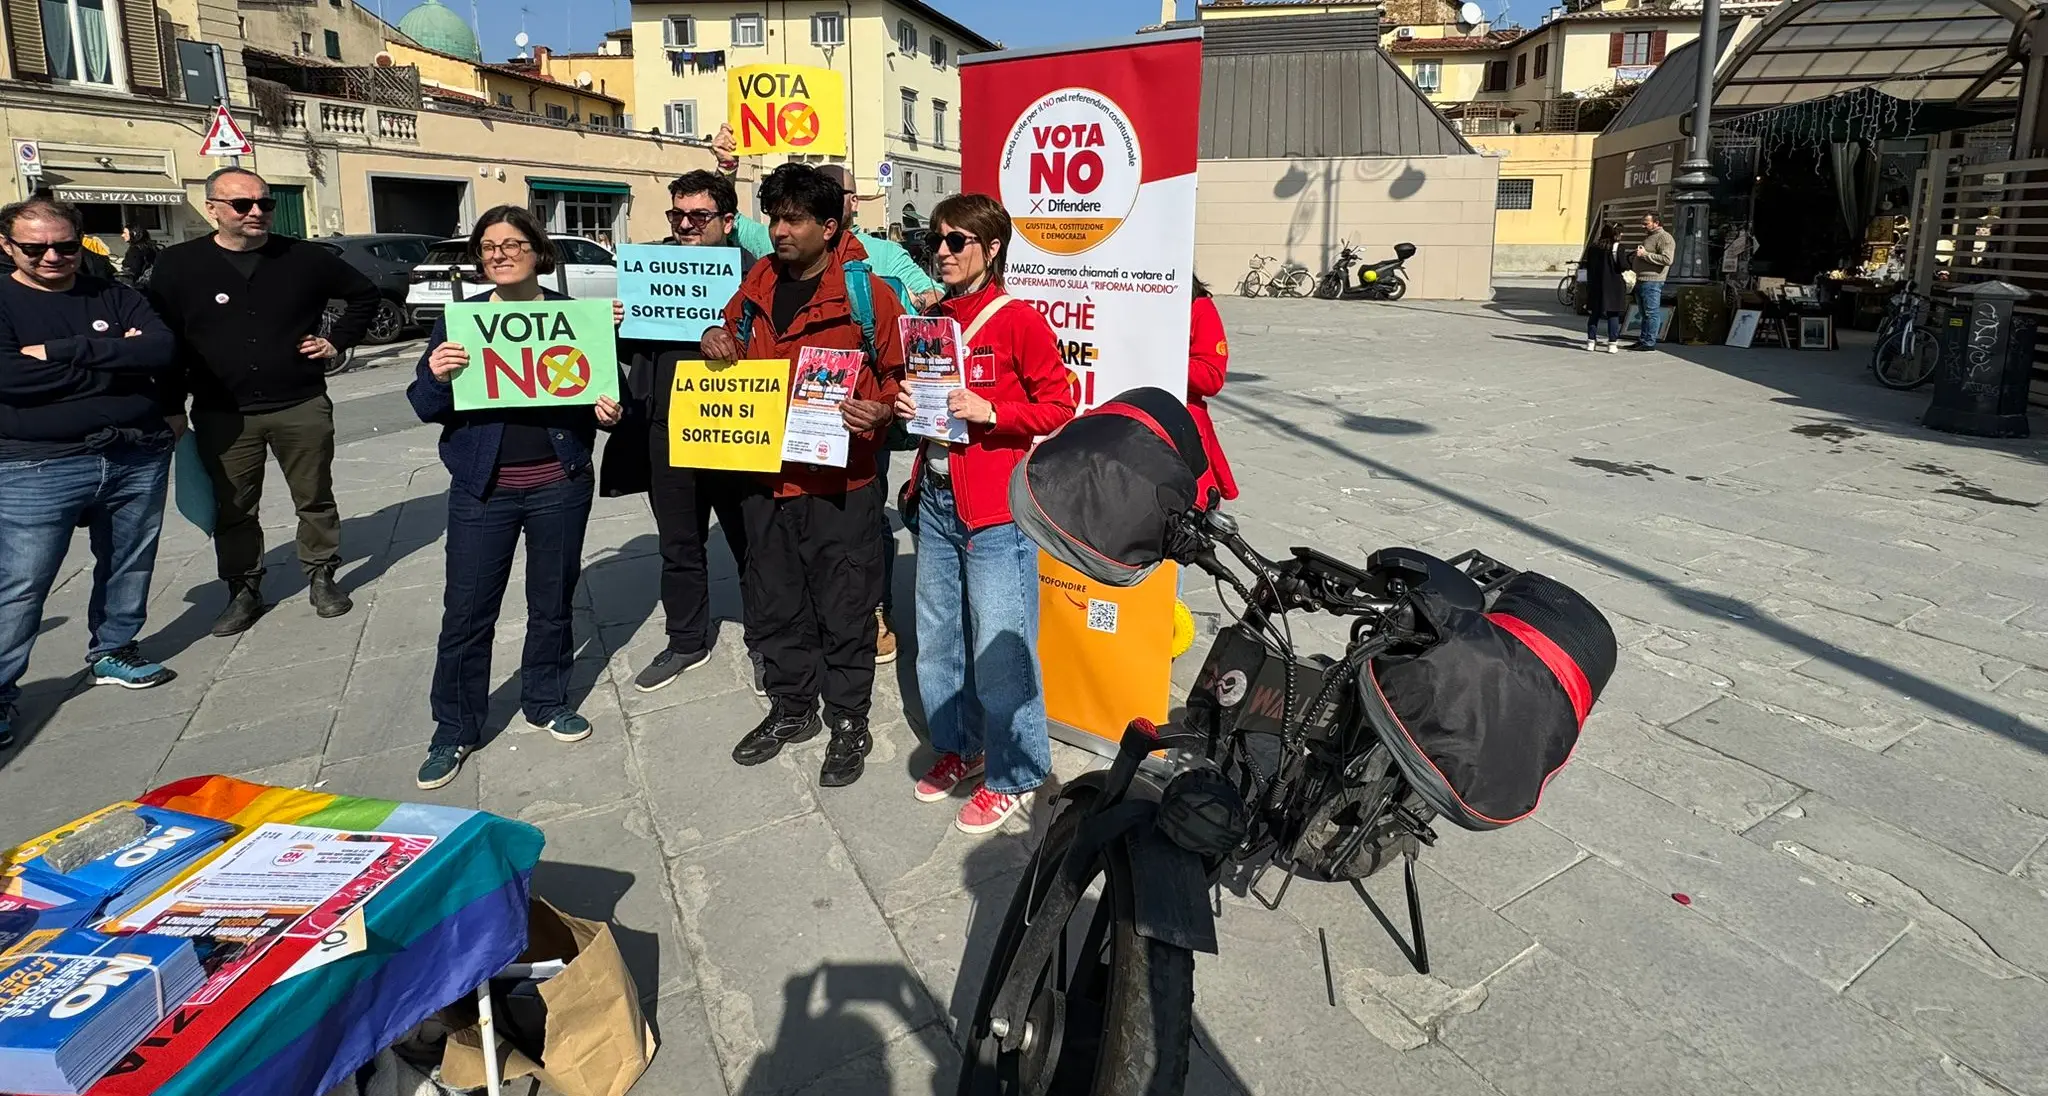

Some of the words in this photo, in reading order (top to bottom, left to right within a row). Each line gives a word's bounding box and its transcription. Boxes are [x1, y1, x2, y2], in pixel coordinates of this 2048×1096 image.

[738, 73, 810, 99] VOTA
[741, 102, 819, 147] NO
[1003, 138, 1017, 170] Società
[1014, 120, 1028, 140] civile
[1027, 109, 1038, 123] per
[1037, 104, 1044, 113] il
[1042, 97, 1055, 109] NO
[1055, 93, 1068, 104] nel
[1068, 93, 1110, 114] referendum
[1108, 110, 1137, 167] costituzionale
[1032, 123, 1105, 149] VOTA
[1029, 150, 1104, 194] NO
[60, 191, 92, 200] PANE
[102, 193, 137, 202] PIZZA
[145, 194, 182, 203] DOLCI
[1048, 199, 1101, 213] Difendere
[1026, 222, 1058, 232] GIUSTIZIA,
[1059, 223, 1104, 231] COSTITUZIONE
[624, 261, 644, 273] LA
[649, 261, 734, 276] GIUSTIZIA
[1011, 263, 1045, 274] MARZO
[1047, 267, 1077, 276] saremo
[1077, 265, 1119, 278] chiamati
[1131, 270, 1162, 280] votare
[1165, 268, 1175, 281] al
[650, 284, 686, 297] NON
[692, 286, 707, 298] SI
[1007, 276, 1066, 288] CONFERMATIVO
[1067, 281, 1088, 289] SULLA
[631, 305, 726, 320] SORTEGGIA
[473, 312, 576, 344] VOTA
[482, 345, 590, 399] NO
[676, 379, 694, 392] LA
[699, 378, 781, 393] GIUSTIZIA
[700, 404, 733, 418] NON
[739, 404, 754, 418] SI
[682, 428, 771, 445] SORTEGGIA
[114, 826, 195, 868] NO
[49, 953, 152, 1019] NO
